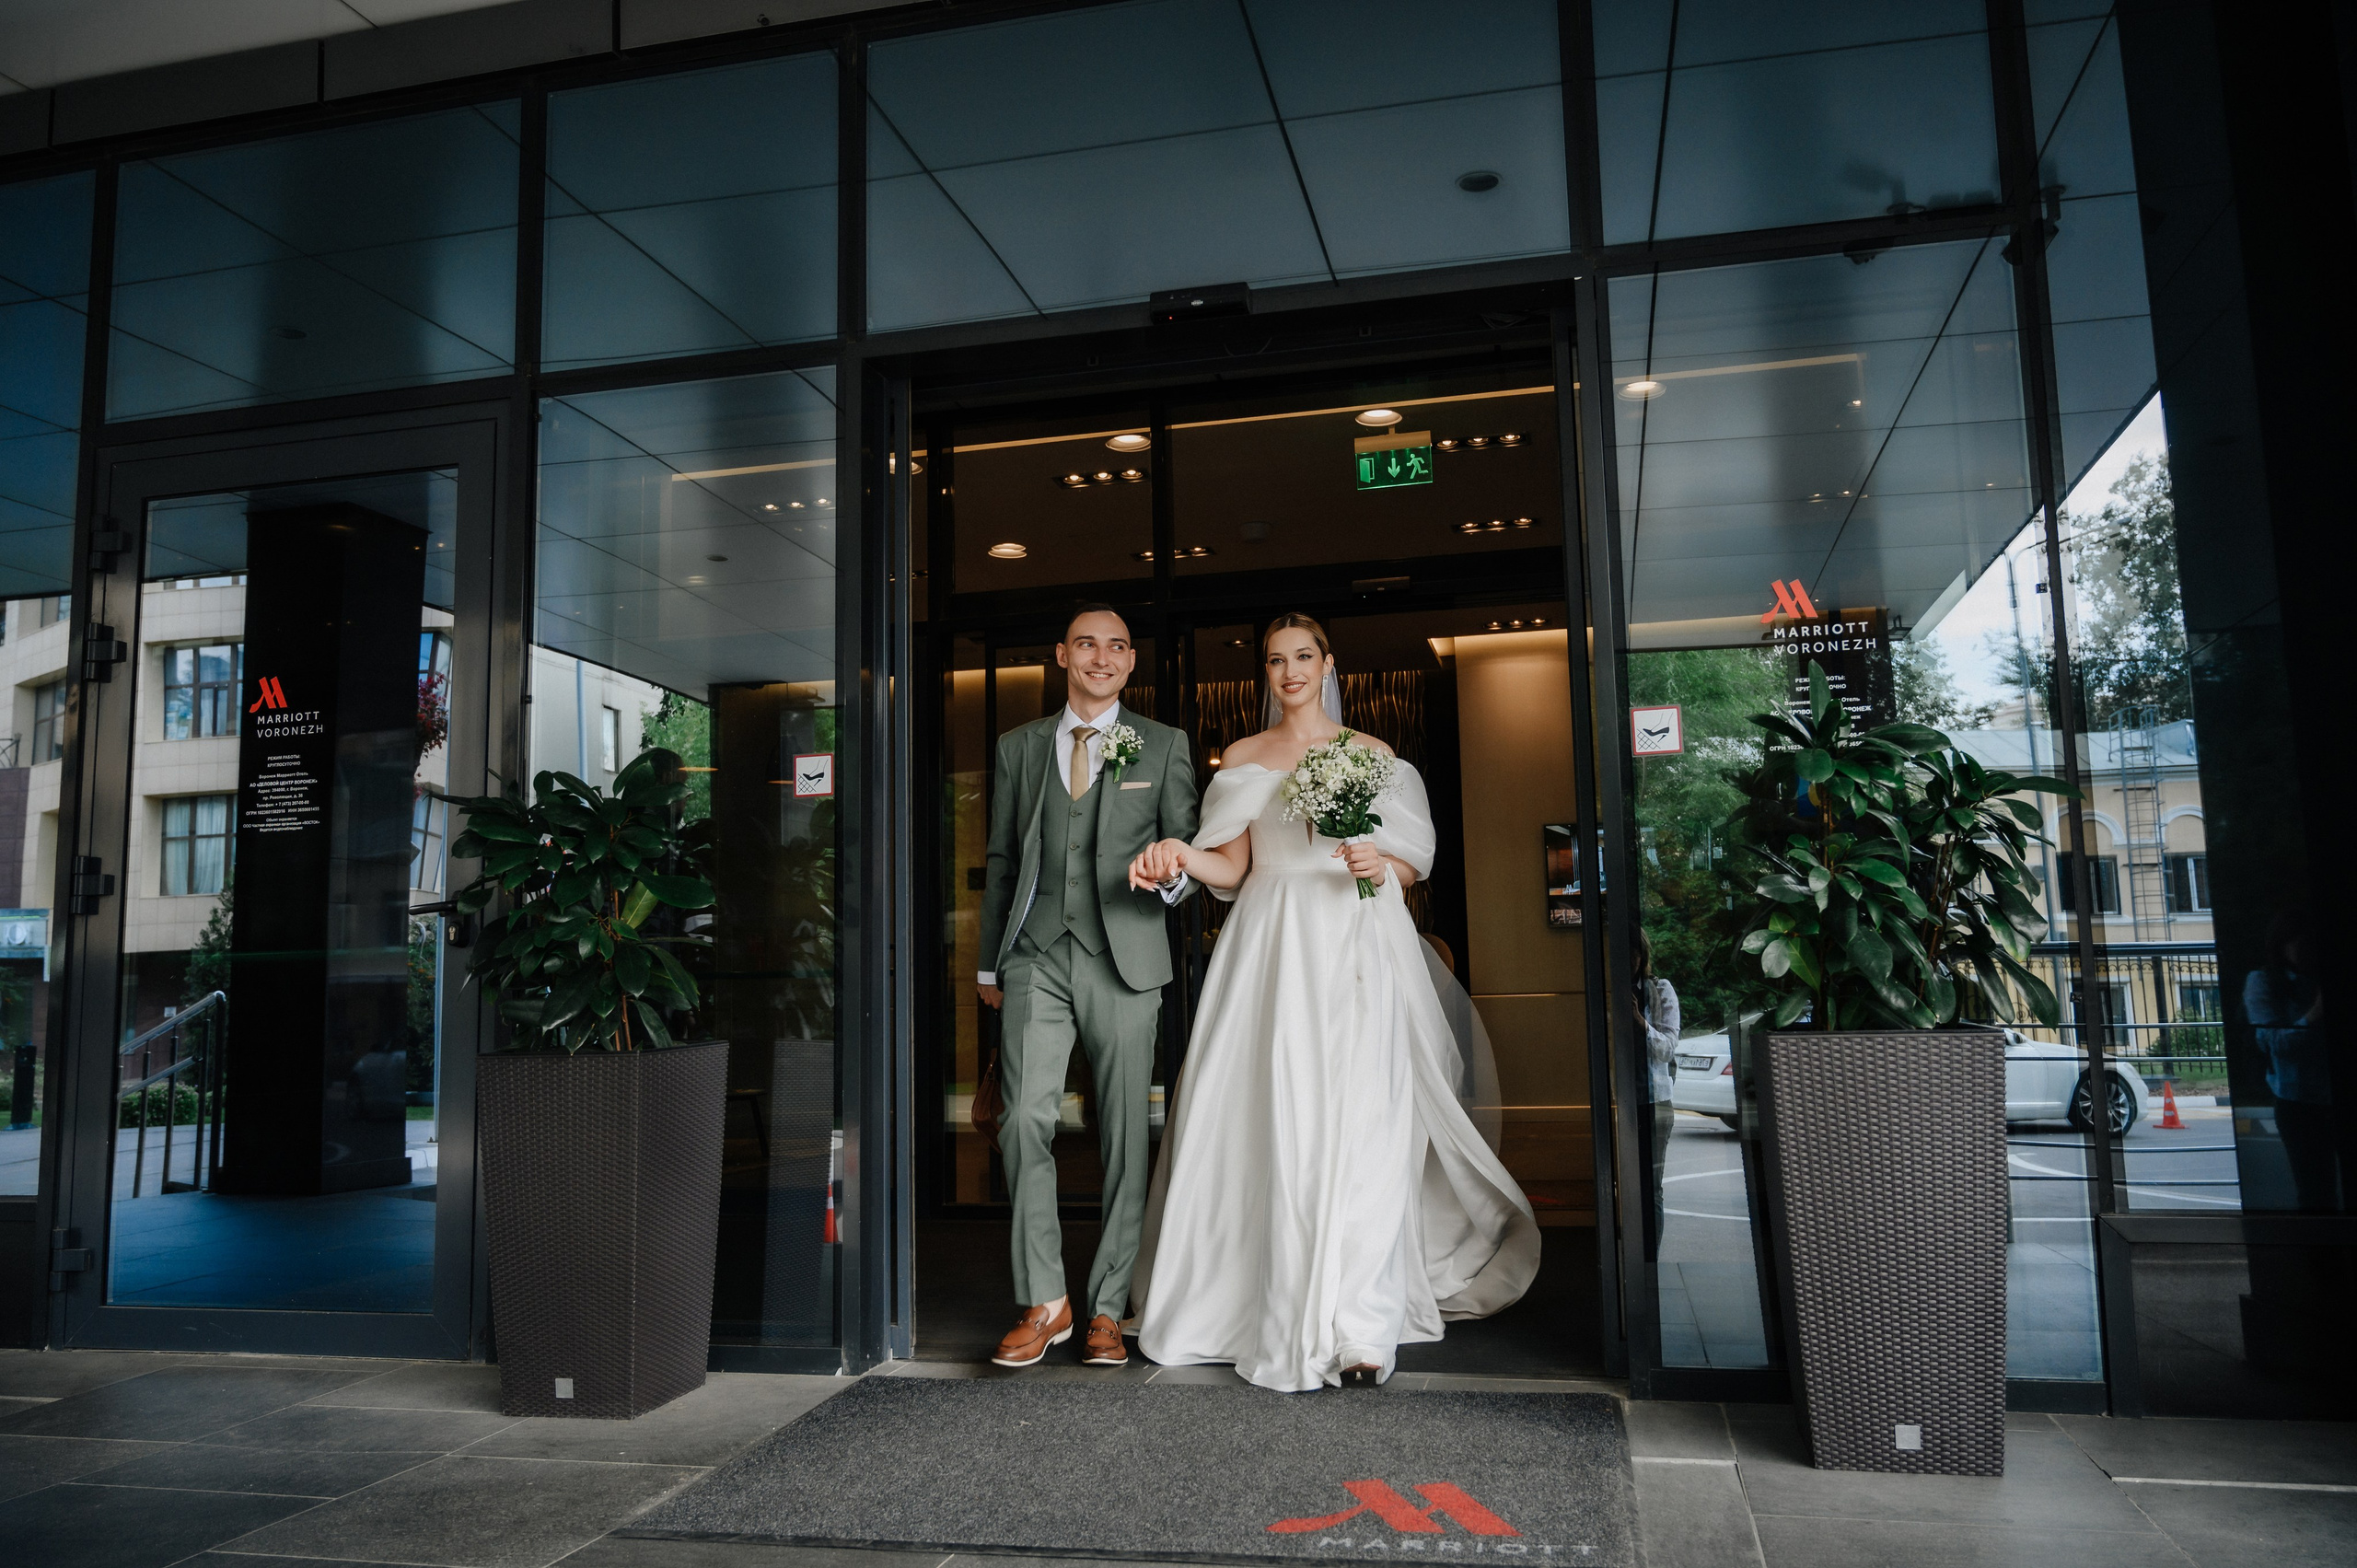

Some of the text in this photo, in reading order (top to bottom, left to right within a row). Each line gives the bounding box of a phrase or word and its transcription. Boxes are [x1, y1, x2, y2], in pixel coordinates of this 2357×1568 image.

[1773, 621, 1868, 639] MARRIOTT
[1774, 637, 1876, 655] VORONEZH
[258, 711, 319, 725] MARRIOTT
[257, 724, 323, 738] VORONEZH
[1318, 1537, 1599, 1557] MARRIOTT
